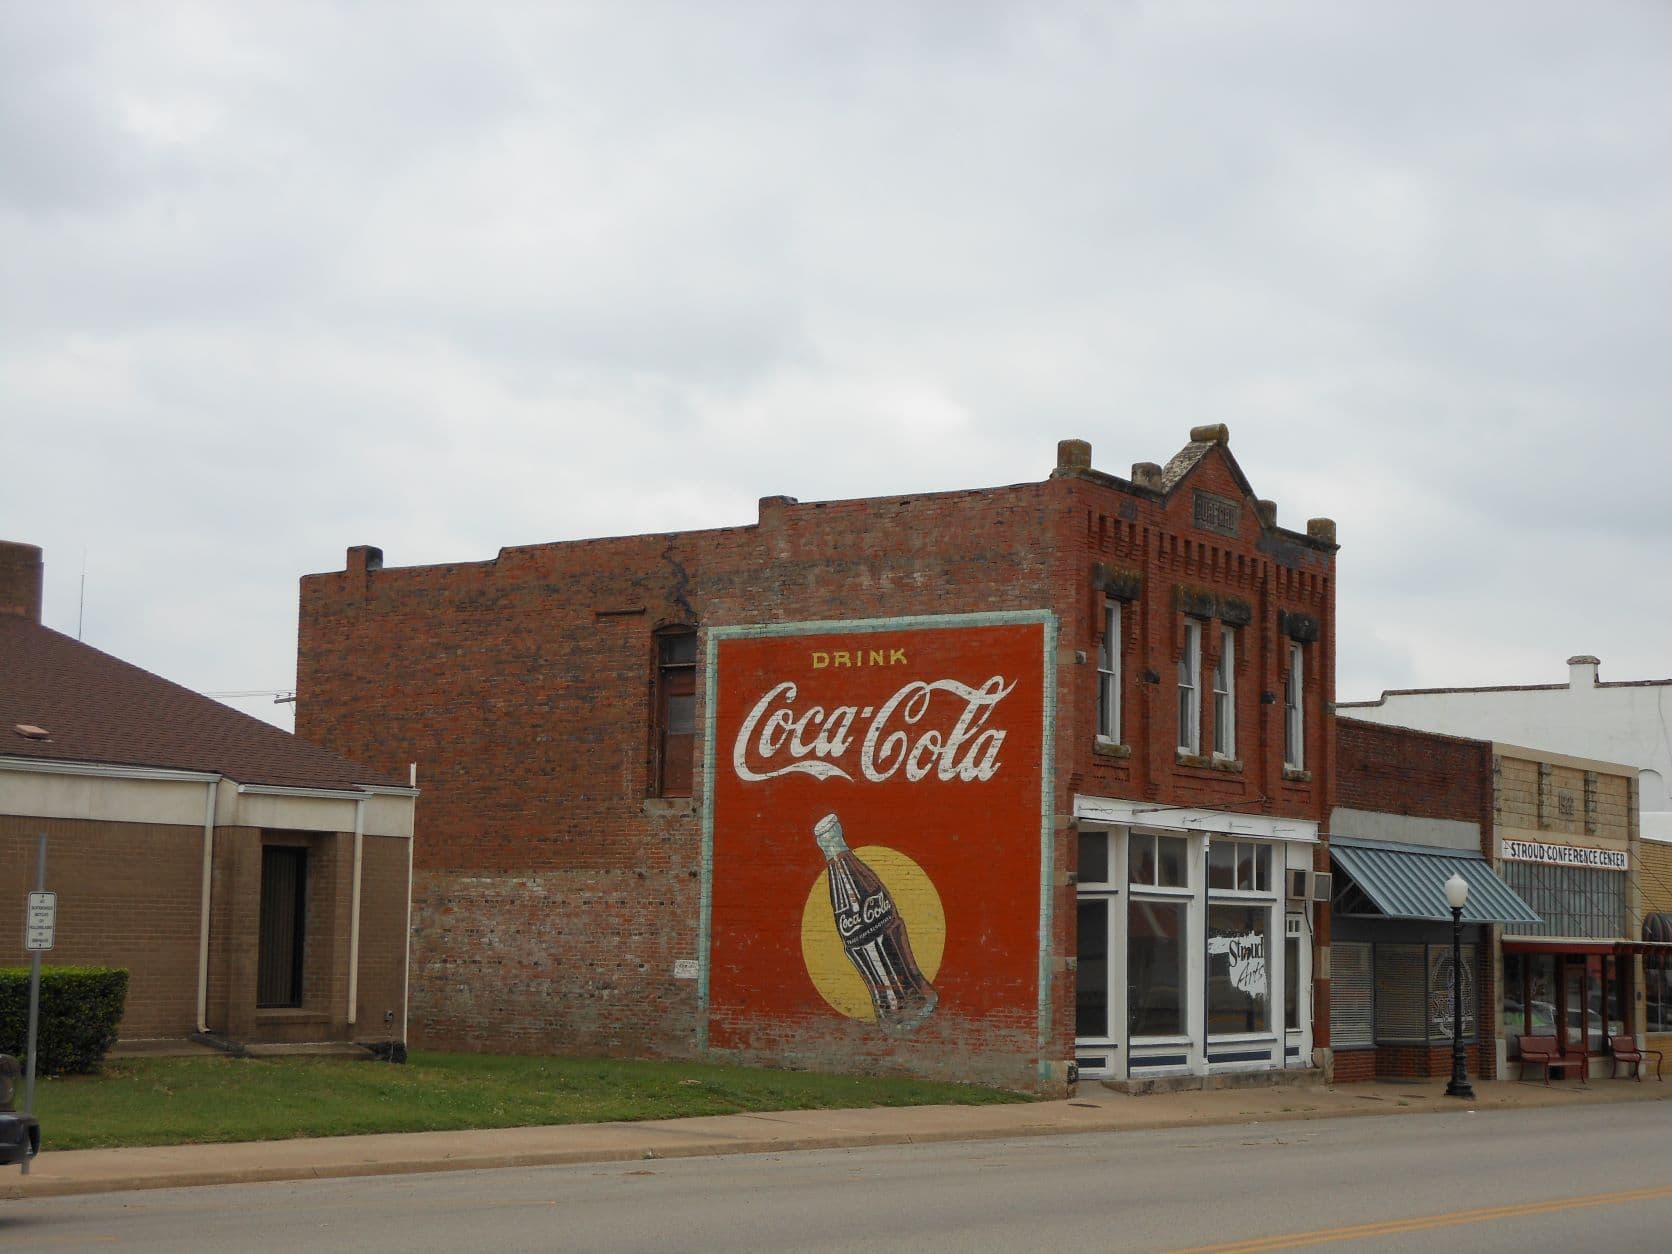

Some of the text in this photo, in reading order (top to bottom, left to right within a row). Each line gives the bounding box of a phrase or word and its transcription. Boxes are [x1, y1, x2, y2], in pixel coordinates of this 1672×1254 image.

[812, 649, 908, 669] DRINK
[733, 675, 1018, 783] Coca-Cola
[1511, 842, 1626, 867] STROUD CONFERENCE CENTER
[839, 914, 865, 936] Coca
[1229, 937, 1264, 967] Stroud
